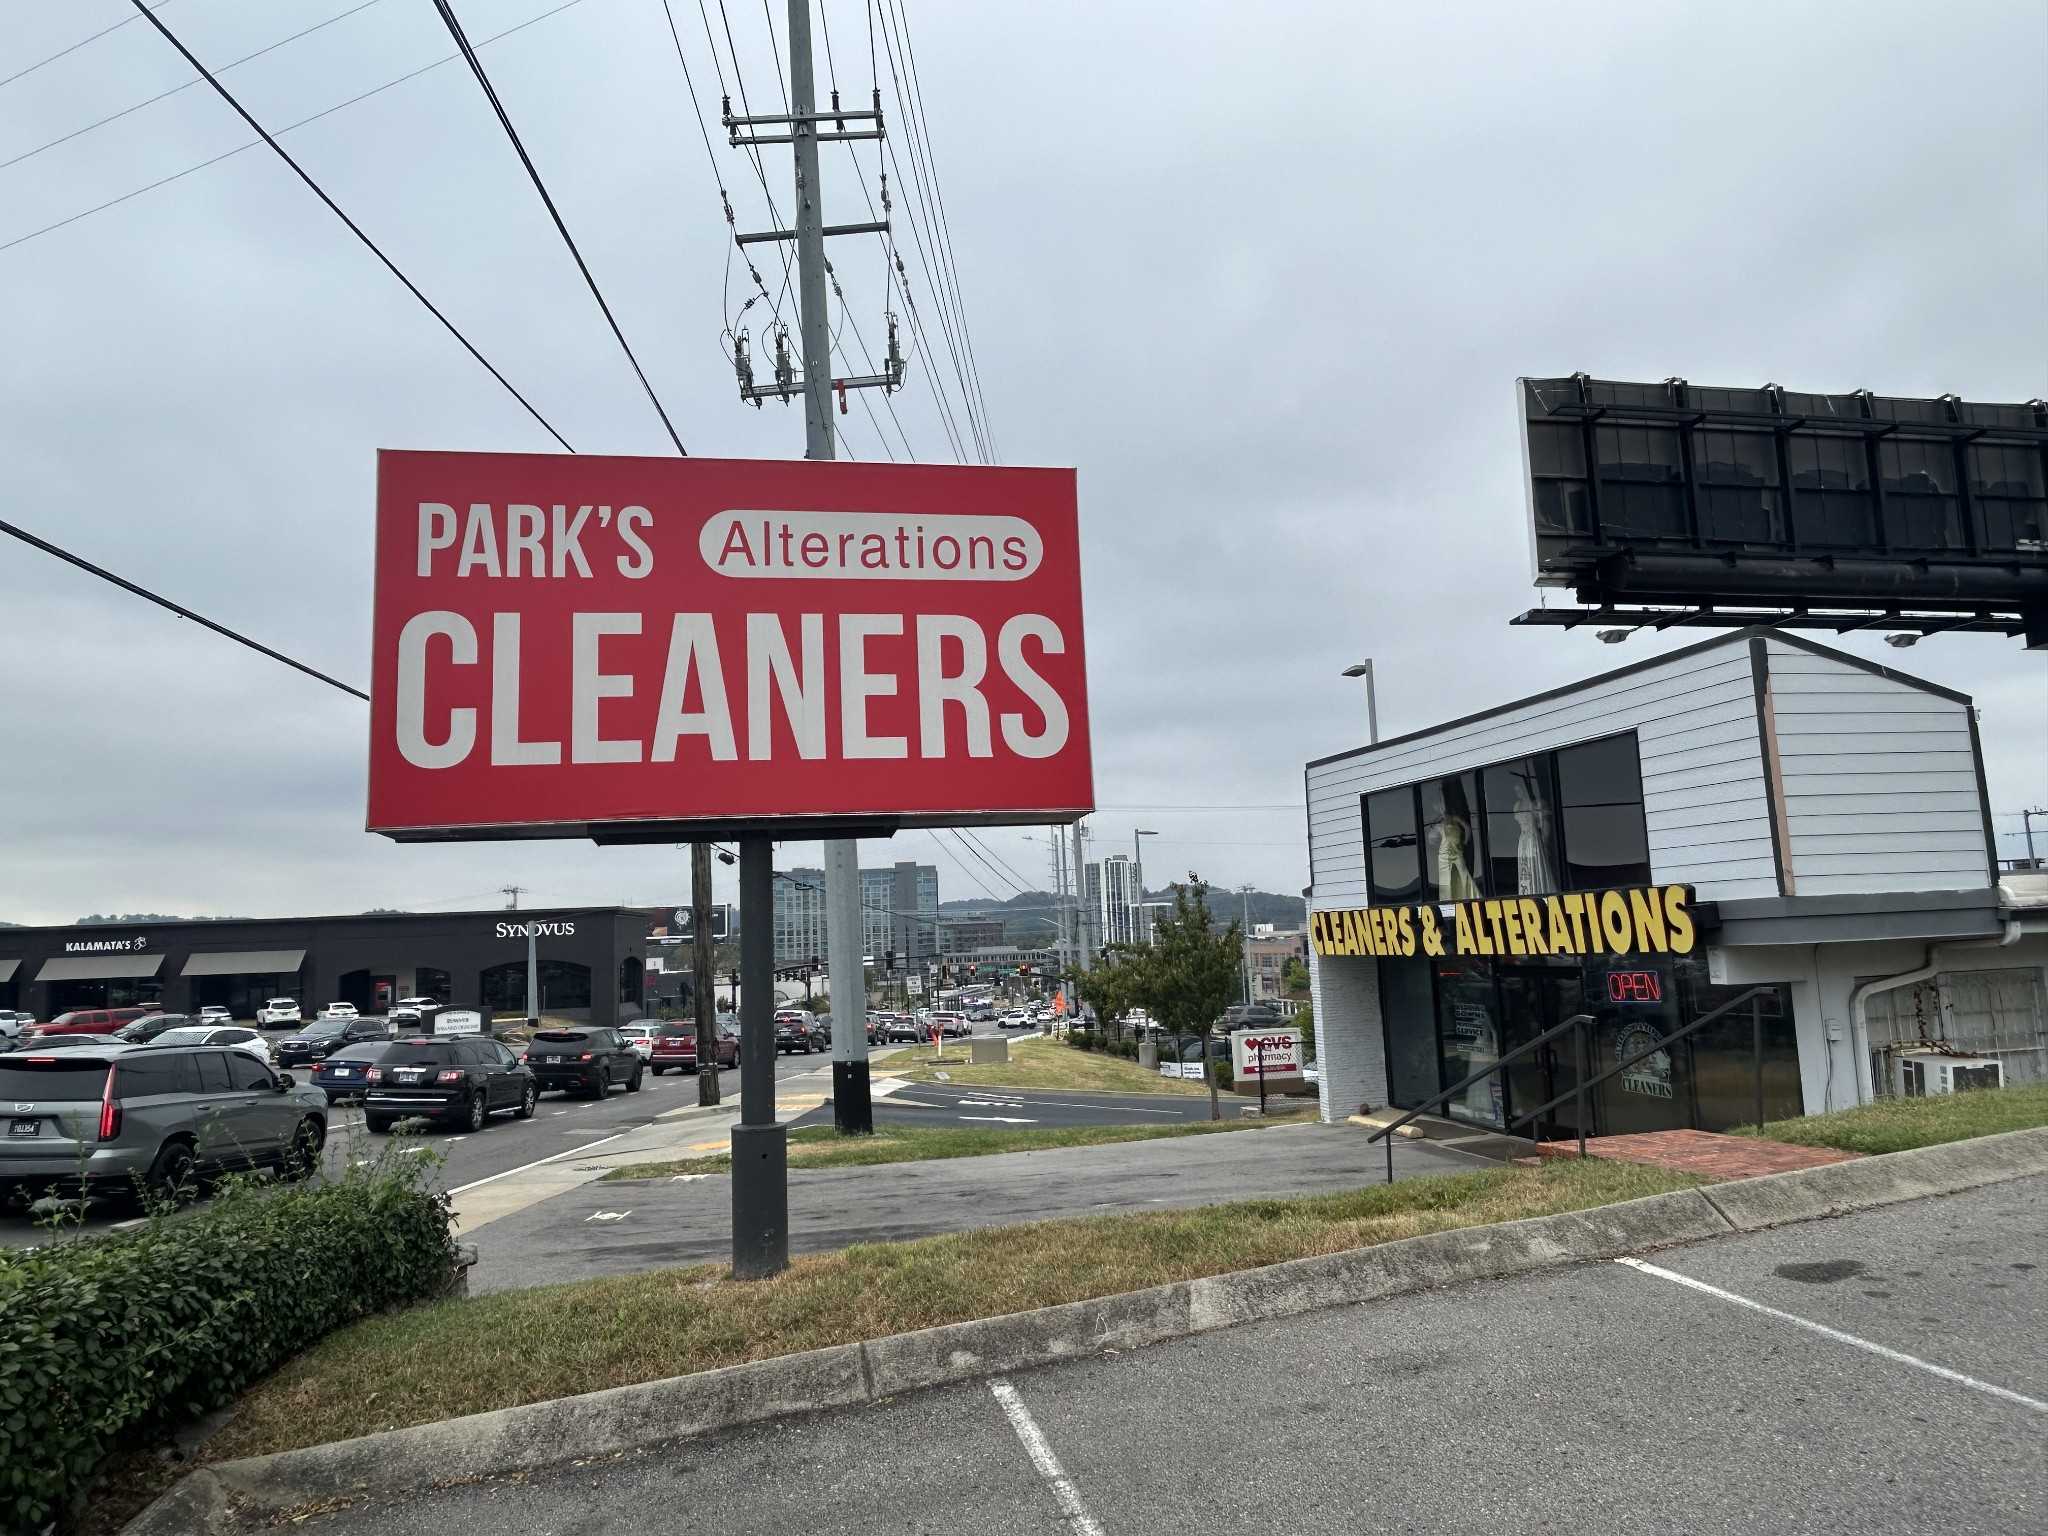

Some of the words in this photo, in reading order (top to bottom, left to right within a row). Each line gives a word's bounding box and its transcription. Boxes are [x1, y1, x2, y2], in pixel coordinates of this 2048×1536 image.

[417, 502, 654, 579] PARK'S
[718, 520, 1028, 572] Alterations
[396, 610, 1070, 770] CLEANERS
[1311, 906, 1416, 957] CLEANERS
[1422, 904, 1446, 956] &
[1456, 885, 1694, 956] ALTERATIONS
[65, 941, 131, 951] KALAMATA'S
[1609, 973, 1660, 1001] OPEN
[1260, 1036, 1292, 1051] CVS
[1622, 1079, 1672, 1098] CLEANERS
